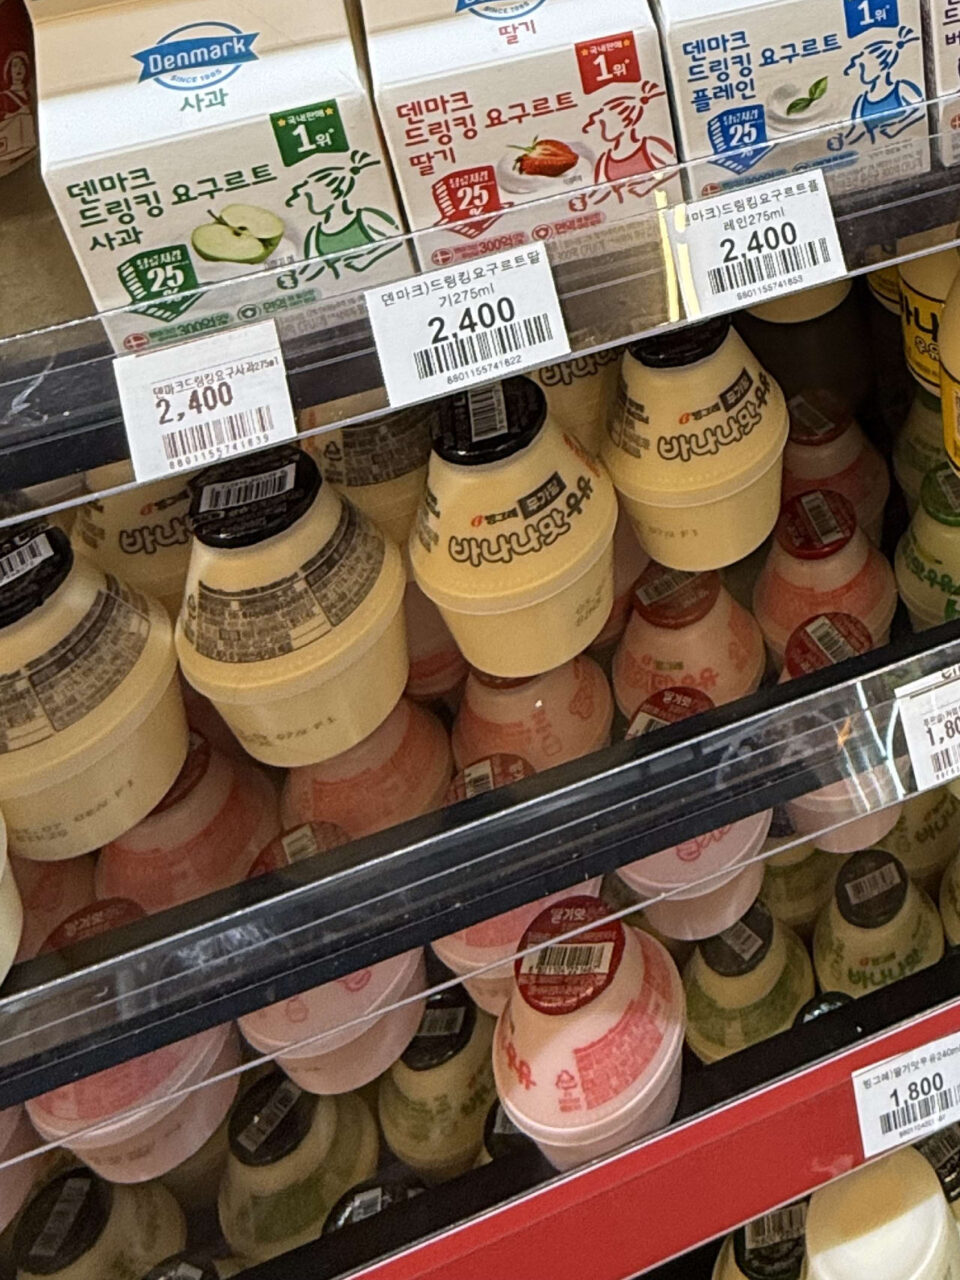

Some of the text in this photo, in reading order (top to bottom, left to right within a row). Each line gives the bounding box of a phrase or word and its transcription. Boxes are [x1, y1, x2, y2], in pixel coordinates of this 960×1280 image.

[499, 20, 536, 46] 딸기
[682, 30, 842, 68] 덴마크 요구르트
[148, 36, 247, 72] Denmark
[687, 53, 752, 82] 드링킹
[180, 87, 229, 113] 사과
[396, 91, 578, 130] 덴마크 요구르트
[691, 78, 757, 113] 플레인
[404, 116, 478, 147] 드링킹
[409, 148, 457, 177] 딸기
[66, 163, 278, 206] 덴마크 요구르트
[79, 191, 165, 227] 드링킹
[685, 179, 819, 227] 마크)드링킹요구르트플
[723, 207, 785, 231] 레인275ml
[90, 226, 144, 253] 사과
[720, 221, 797, 263] 2,400
[381, 250, 541, 307] 덴마크)드링킹요구르트딸
[439, 283, 495, 308] 기275ml
[427, 296, 515, 344] 2,400
[156, 381, 233, 425] 2,400
[890, 1072, 944, 1108] 1,800
